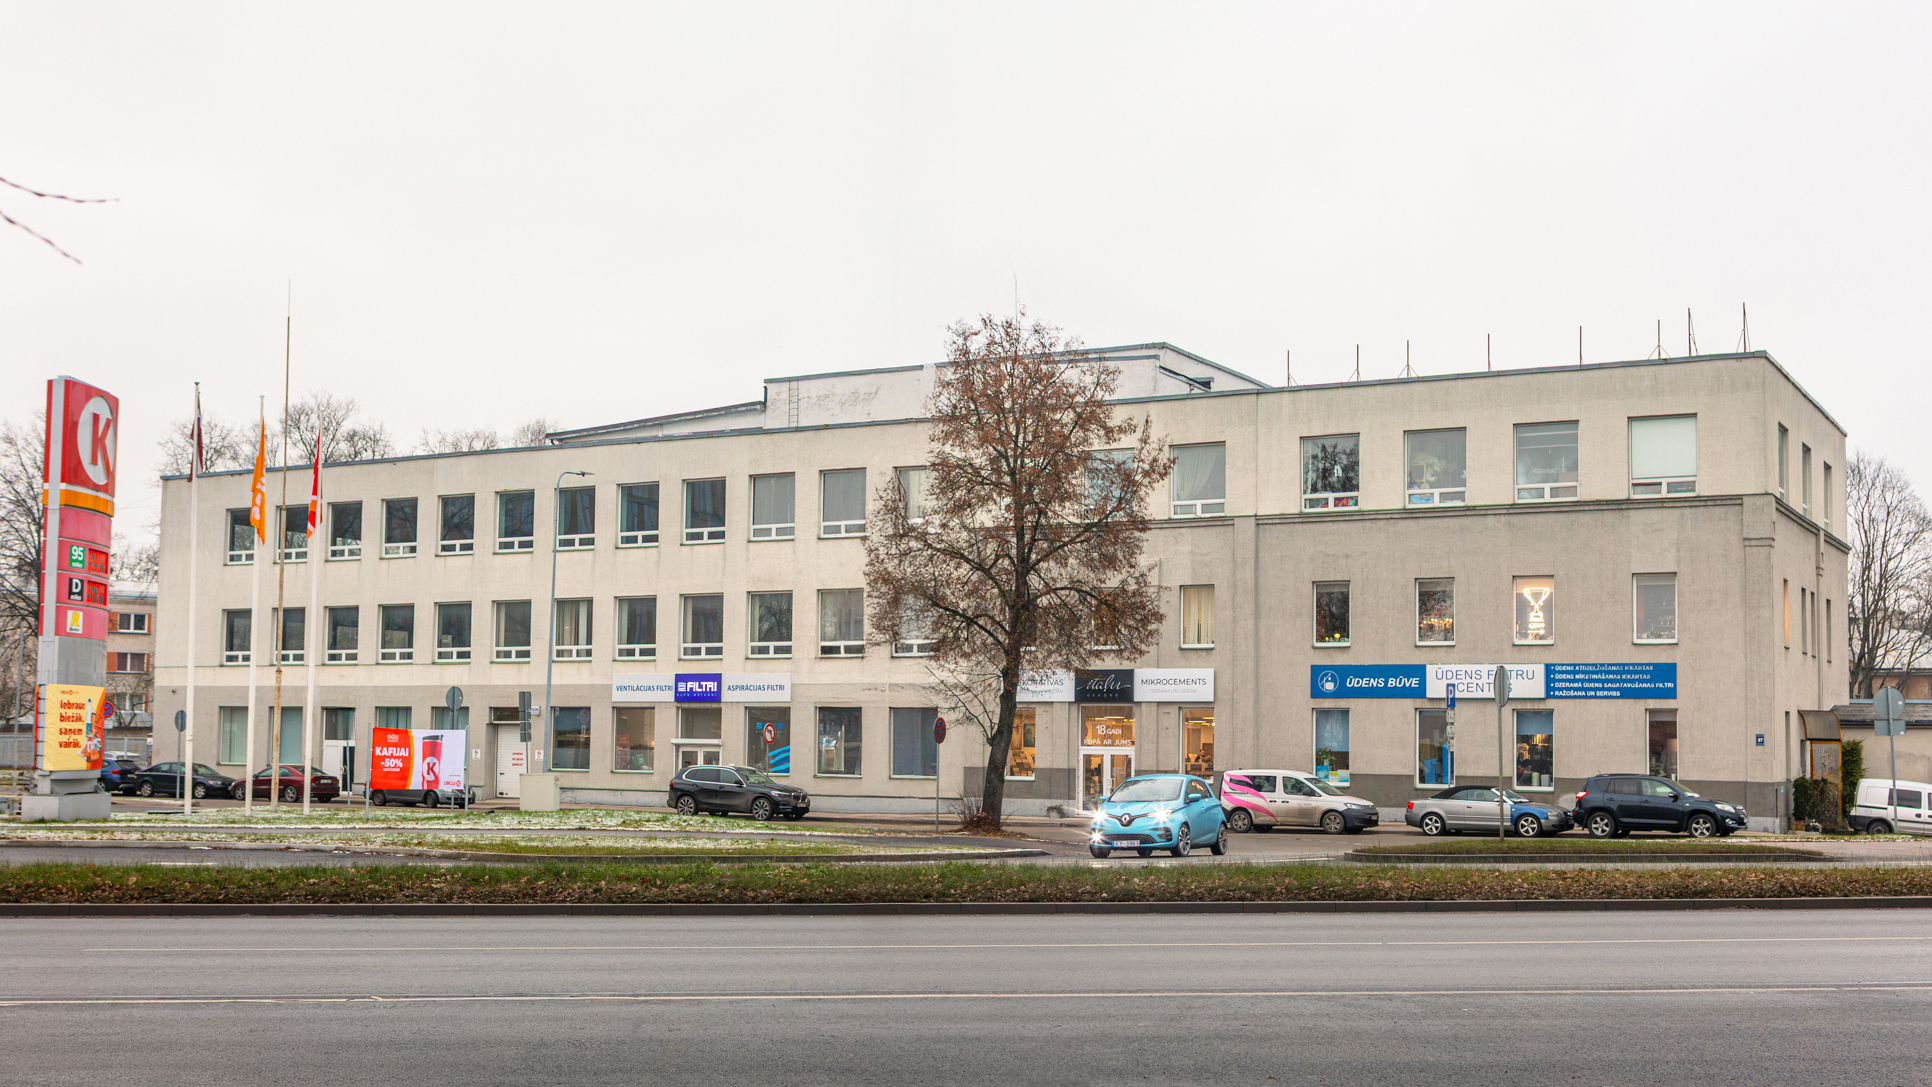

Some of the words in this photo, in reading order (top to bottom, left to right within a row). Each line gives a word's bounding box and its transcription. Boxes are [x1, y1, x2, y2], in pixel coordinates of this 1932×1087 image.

[90, 411, 113, 481] K
[71, 546, 84, 561] 95
[72, 578, 82, 593] D
[1435, 668, 1483, 680] ŪDENS
[1487, 669, 1535, 680] FTRU
[687, 682, 717, 691] FILTRI
[1346, 676, 1385, 687] ŪDENS
[1387, 676, 1420, 687] BŪVE
[1456, 682, 1513, 693] CENTS
[1448, 686, 1454, 705] P
[1096, 725, 1106, 735] 18
[375, 746, 409, 756] KAFIJAI
[381, 758, 403, 767] -50%
[426, 762, 438, 777] K
